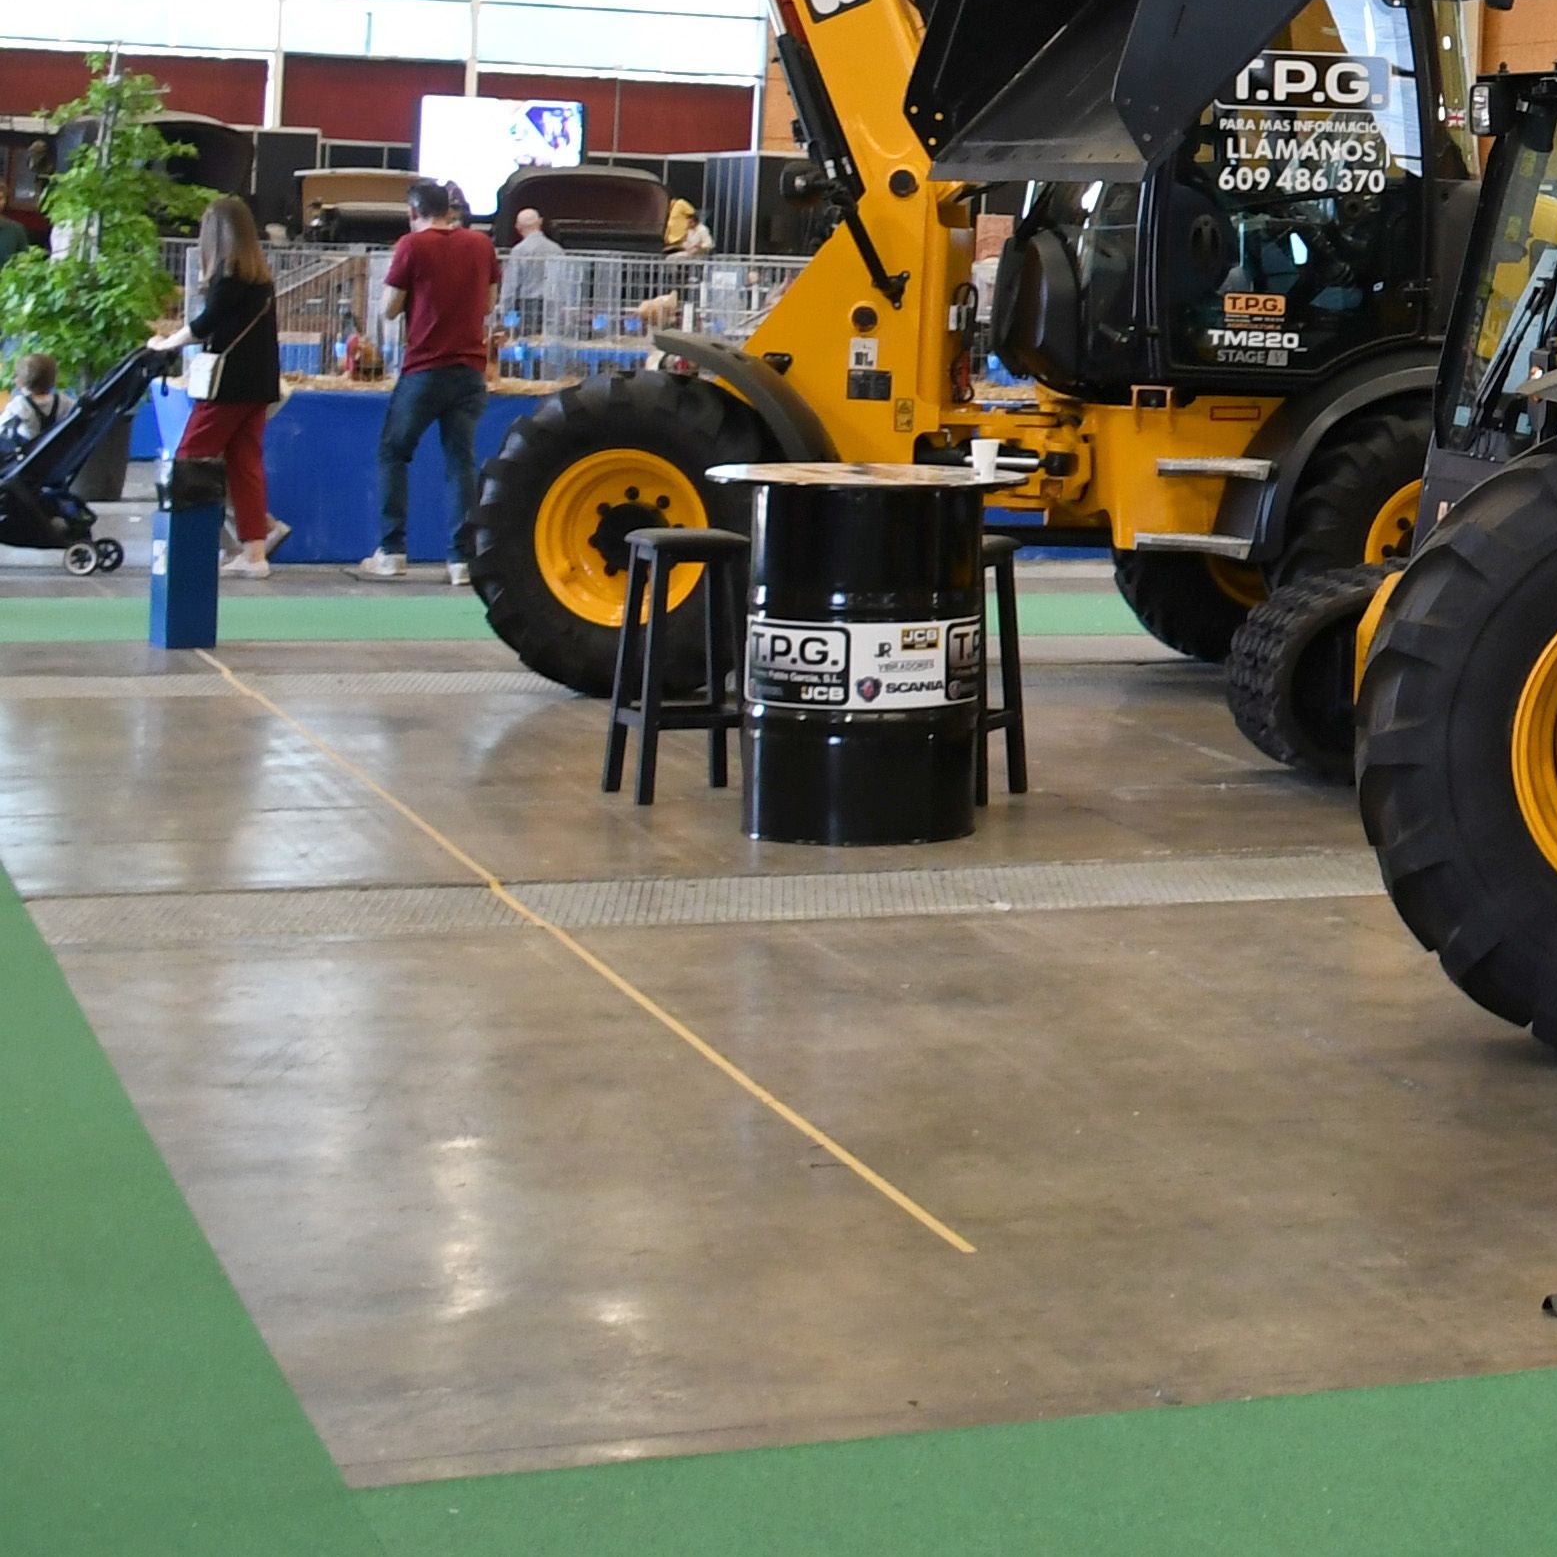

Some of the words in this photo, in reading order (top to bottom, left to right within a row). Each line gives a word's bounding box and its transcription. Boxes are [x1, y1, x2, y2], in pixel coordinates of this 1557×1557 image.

[1236, 59, 1384, 104] T.P.G.
[1219, 117, 1256, 131] PARA
[1259, 119, 1291, 132] MAS
[1227, 131, 1378, 163] LLÁMANOS
[1218, 166, 1272, 192] 609
[1276, 167, 1329, 193] 486
[1336, 168, 1386, 194] 370
[1227, 296, 1283, 313] T.P.G.
[1207, 329, 1300, 349] TM220
[1217, 349, 1267, 364] STAGE
[903, 629, 938, 643] JCB
[752, 632, 840, 667] T.P.G.
[800, 686, 845, 701] JCB
[885, 680, 945, 695] SCANIA
